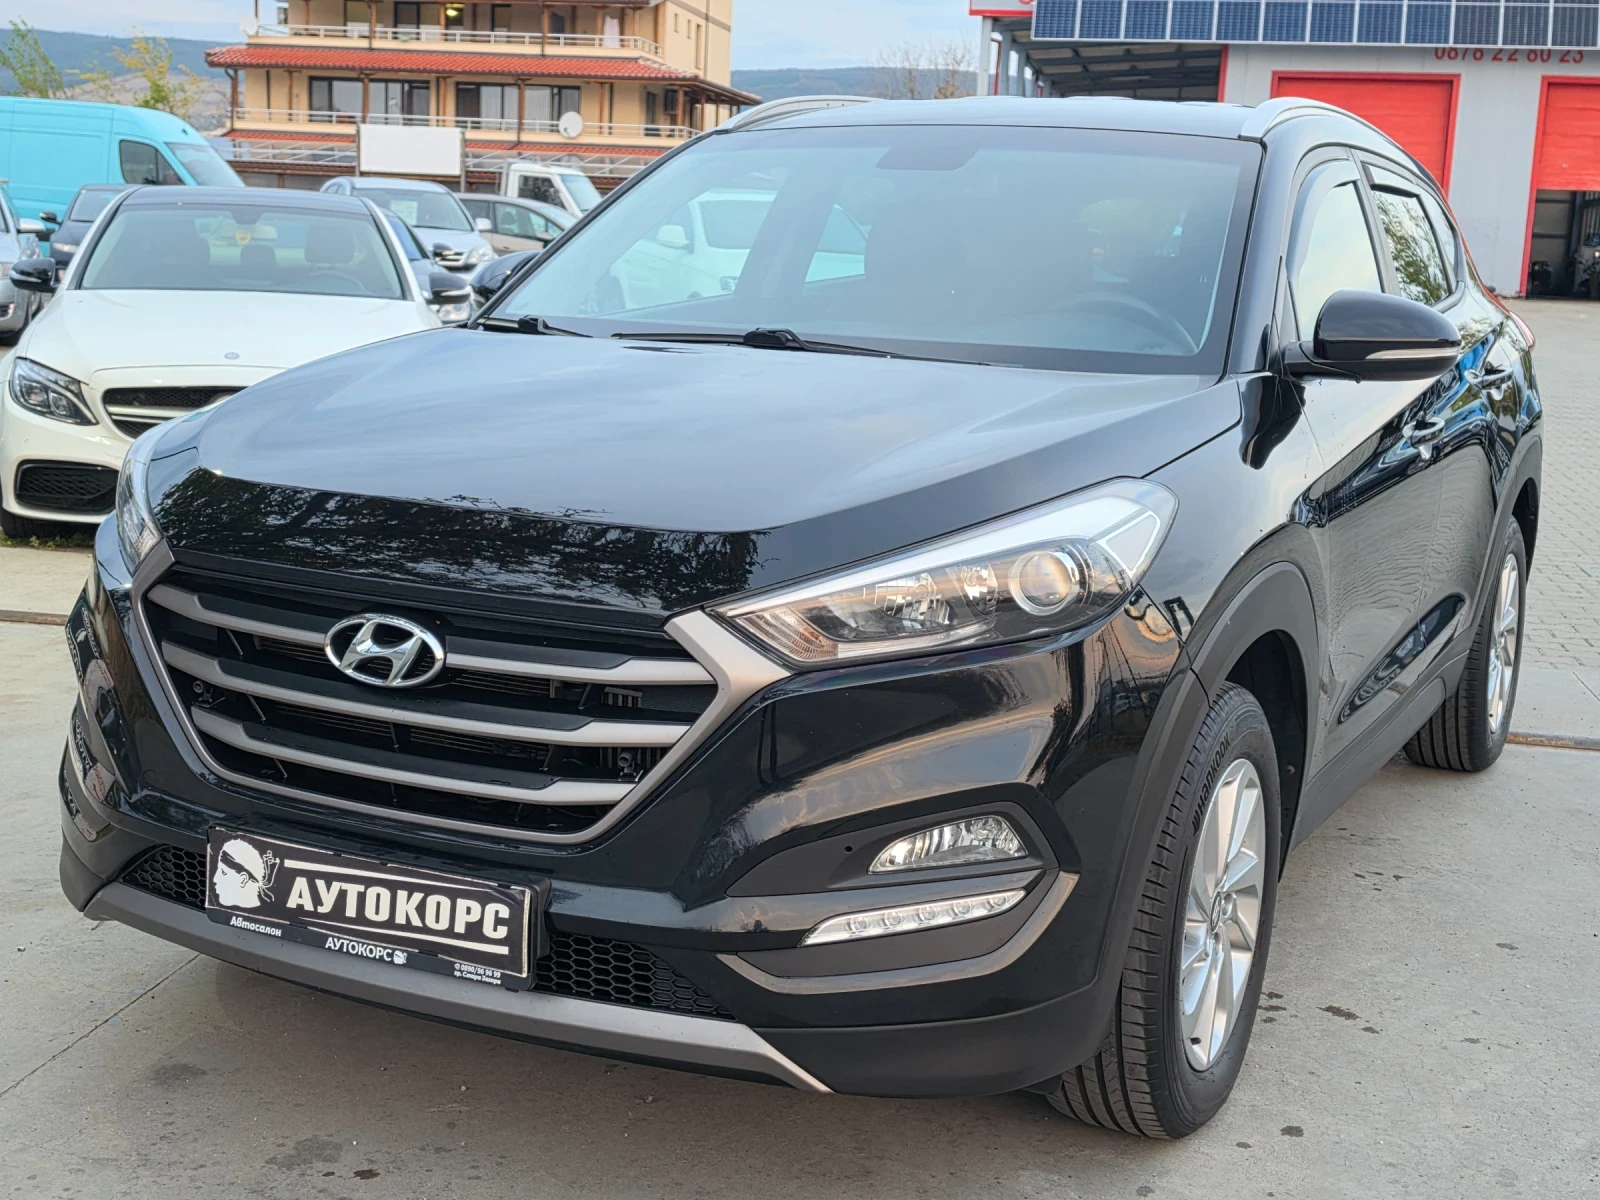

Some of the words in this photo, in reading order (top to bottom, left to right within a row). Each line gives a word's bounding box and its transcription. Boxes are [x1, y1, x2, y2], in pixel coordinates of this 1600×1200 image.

[286, 876, 510, 939] АУТОКОРС
[229, 915, 282, 937] Автосалон
[325, 936, 393, 964] АУТОКОРС
